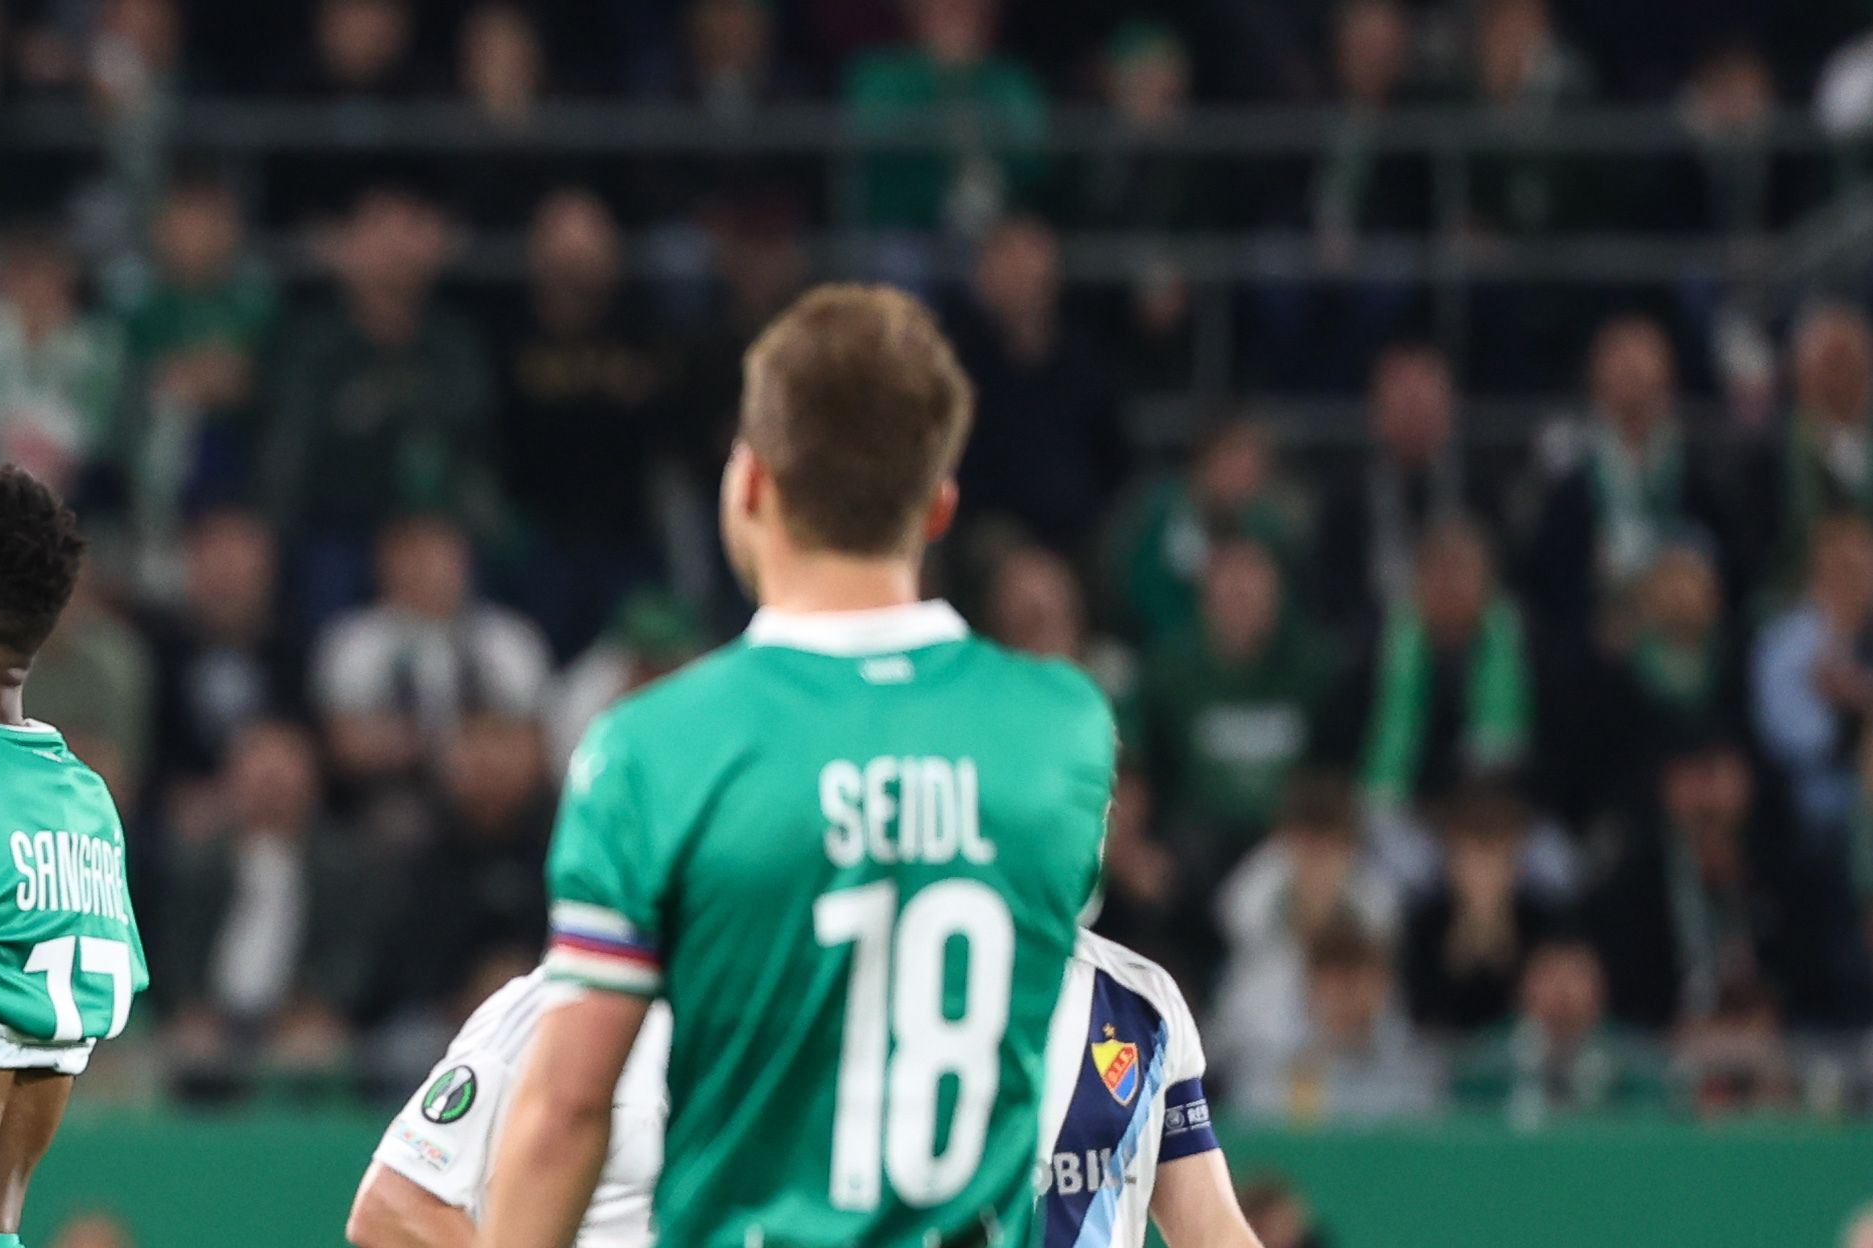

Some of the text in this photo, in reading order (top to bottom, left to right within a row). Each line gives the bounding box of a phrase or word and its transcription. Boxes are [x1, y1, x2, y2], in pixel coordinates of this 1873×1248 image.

[818, 756, 996, 867] SEIDL
[23, 934, 133, 1041] 17
[813, 876, 1015, 1212] 18
